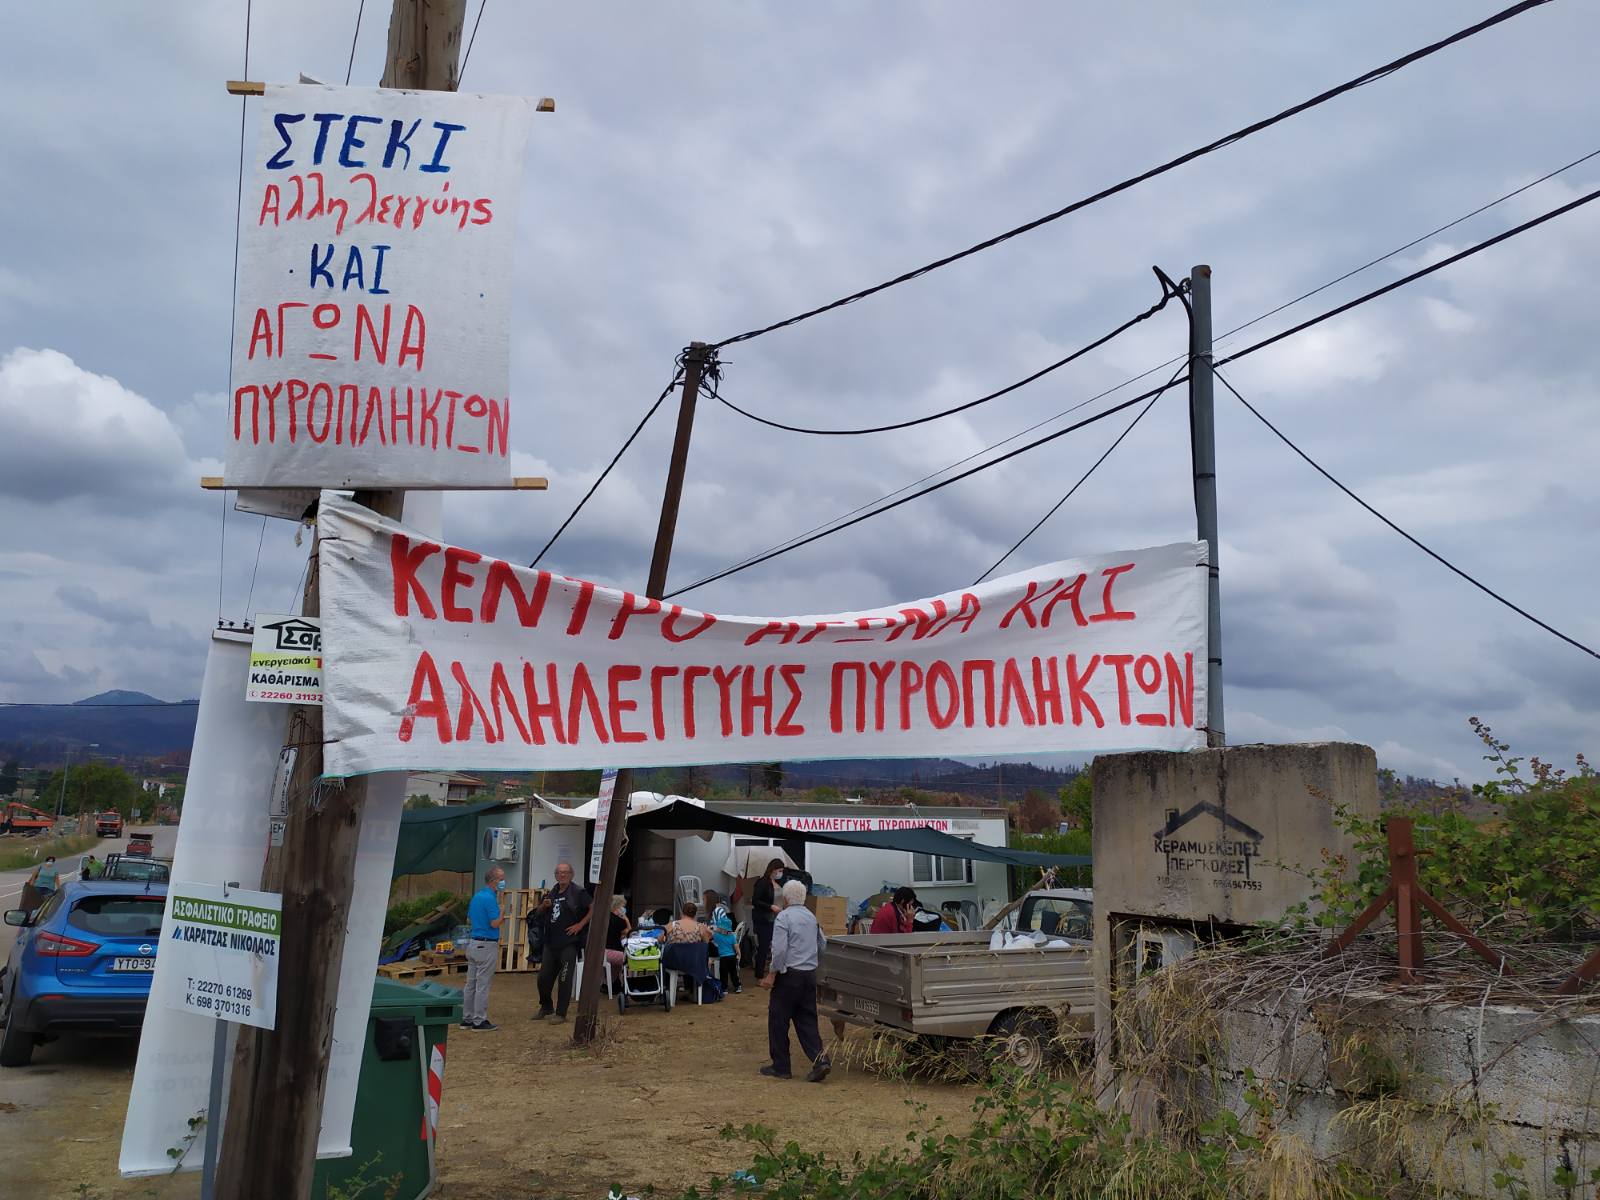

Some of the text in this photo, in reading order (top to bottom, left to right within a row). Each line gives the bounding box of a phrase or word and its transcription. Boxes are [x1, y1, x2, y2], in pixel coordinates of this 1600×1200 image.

[266, 113, 467, 173] ΣΤΕΚΙ
[259, 172, 493, 235] Αλληλεγγύης
[310, 243, 391, 294] ΚΑΙ
[248, 302, 426, 372] ΑΓΩΝΑ
[234, 379, 510, 457] ΠΥΡΟΠΛΗΚΤΩΝ
[390, 533, 717, 643] ΚΕΝΤΡΟ
[1000, 563, 1136, 628] ΚΑΙ
[260, 691, 293, 700] 22260
[398, 650, 1194, 745] ΑΛΛΗΛΕΓΓΥΗΣ ΠΥΡΟΠΛΗΚΤΩΝ
[796, 818, 871, 832] ΑΛΛΗΛΕΓΓΥΗΣ
[173, 899, 277, 931] ΑΣΦΑΛΙΣΤΙΚΟ ΓΡΑΦΕΙΟ
[184, 925, 276, 956] ΚΑΡΑΤΖΑΣ ΝΙΚΟΛΑΟΣ
[196, 995, 212, 1010] 698
[214, 998, 251, 1017] 3701316
[197, 980, 224, 995] 22270
[226, 985, 252, 1001] 61269
